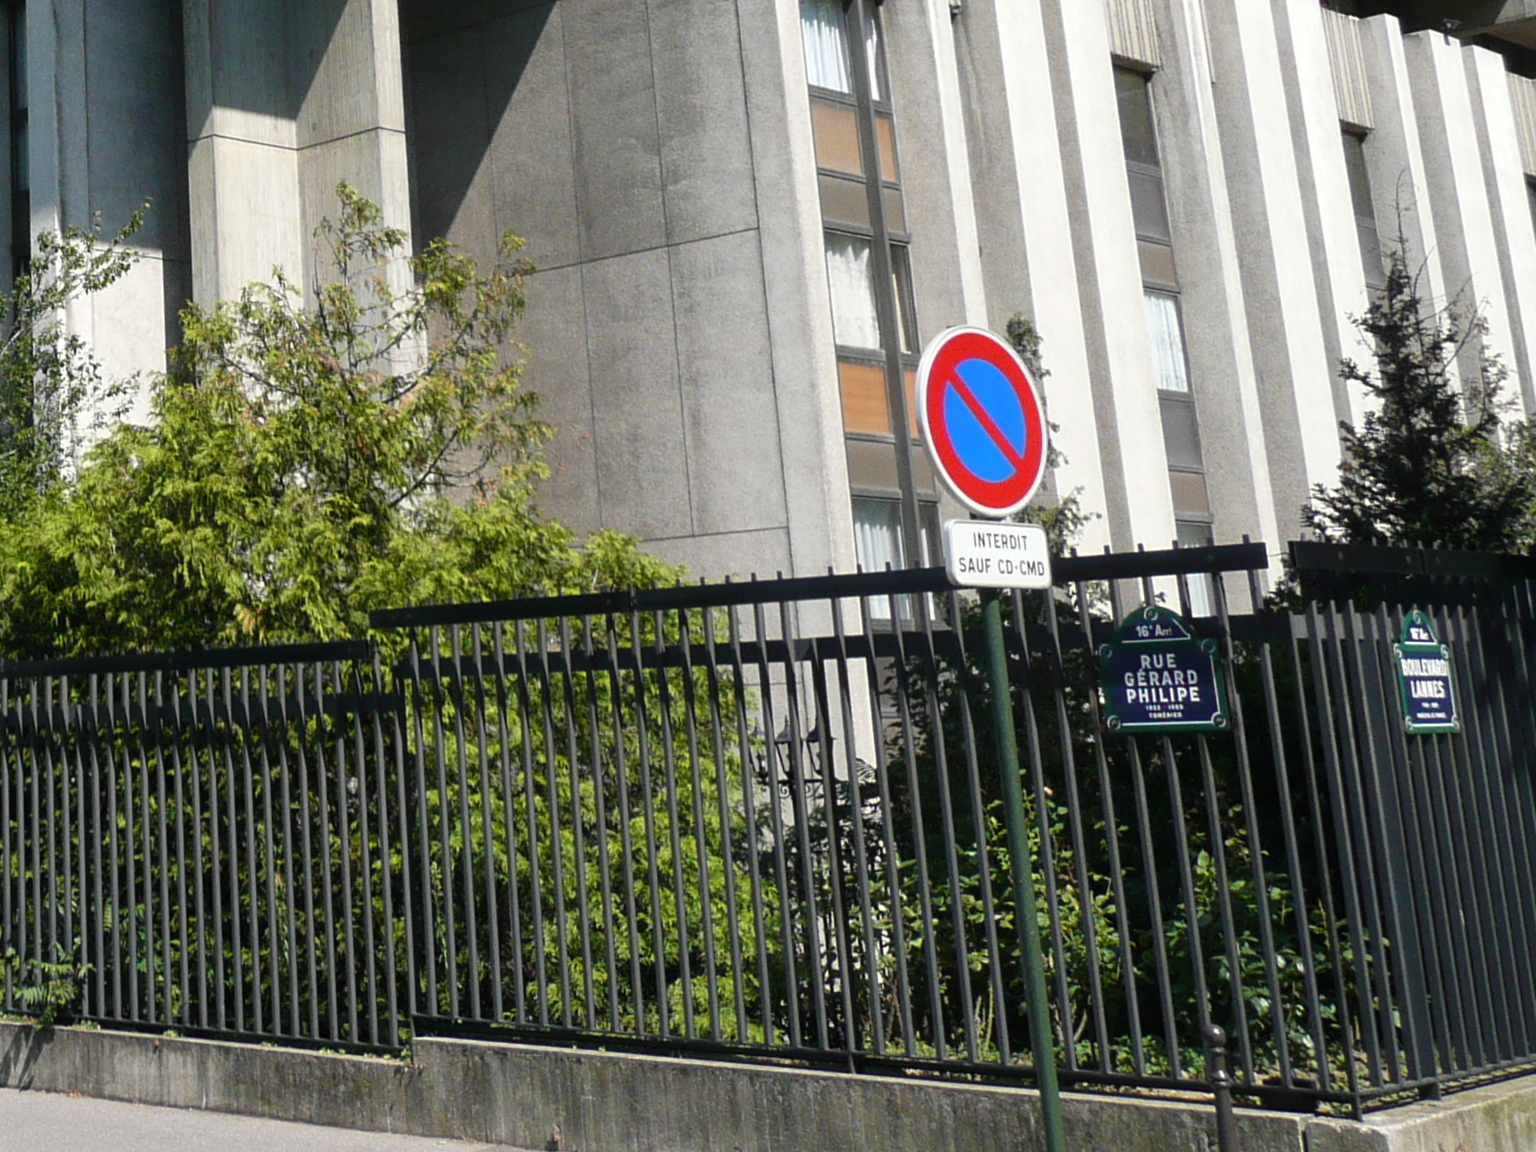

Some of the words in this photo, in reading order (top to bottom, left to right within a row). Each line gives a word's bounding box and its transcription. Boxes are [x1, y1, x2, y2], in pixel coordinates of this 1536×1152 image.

[973, 532, 1027, 550] INTERDIT
[958, 557, 991, 573] SAUF
[1141, 653, 1177, 669] RUE
[1400, 658, 1447, 675] BOULEVARD
[1124, 668, 1198, 687] GÉRARD
[1126, 687, 1200, 703] PHILIPE
